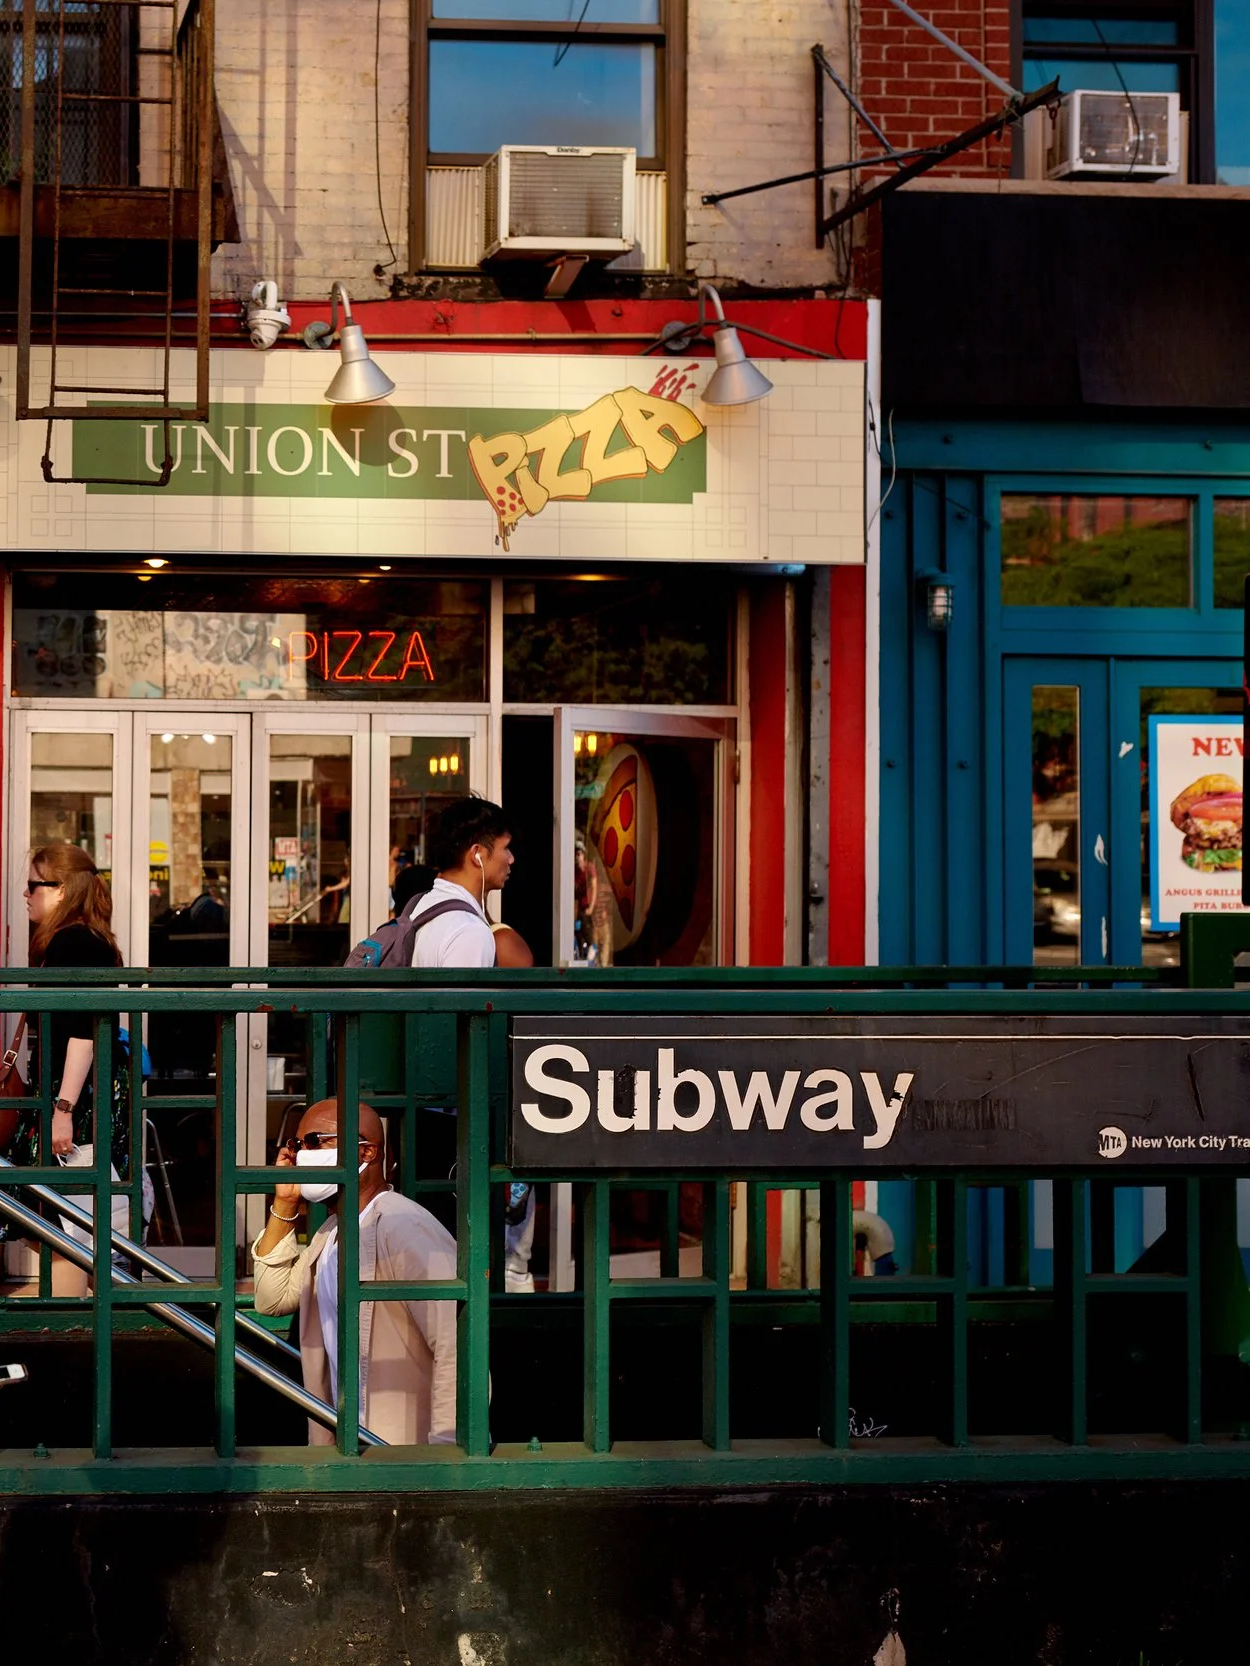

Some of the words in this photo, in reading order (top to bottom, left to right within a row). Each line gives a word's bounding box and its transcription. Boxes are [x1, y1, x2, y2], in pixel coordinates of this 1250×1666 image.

[140, 423, 365, 477] UNION
[387, 428, 466, 478] ST
[468, 385, 705, 534] PIZZA
[287, 630, 435, 682] PIZZA
[519, 1044, 914, 1149] Subway
[1131, 1136, 1163, 1148] New
[1164, 1136, 1196, 1148] York
[1199, 1136, 1226, 1150] City
